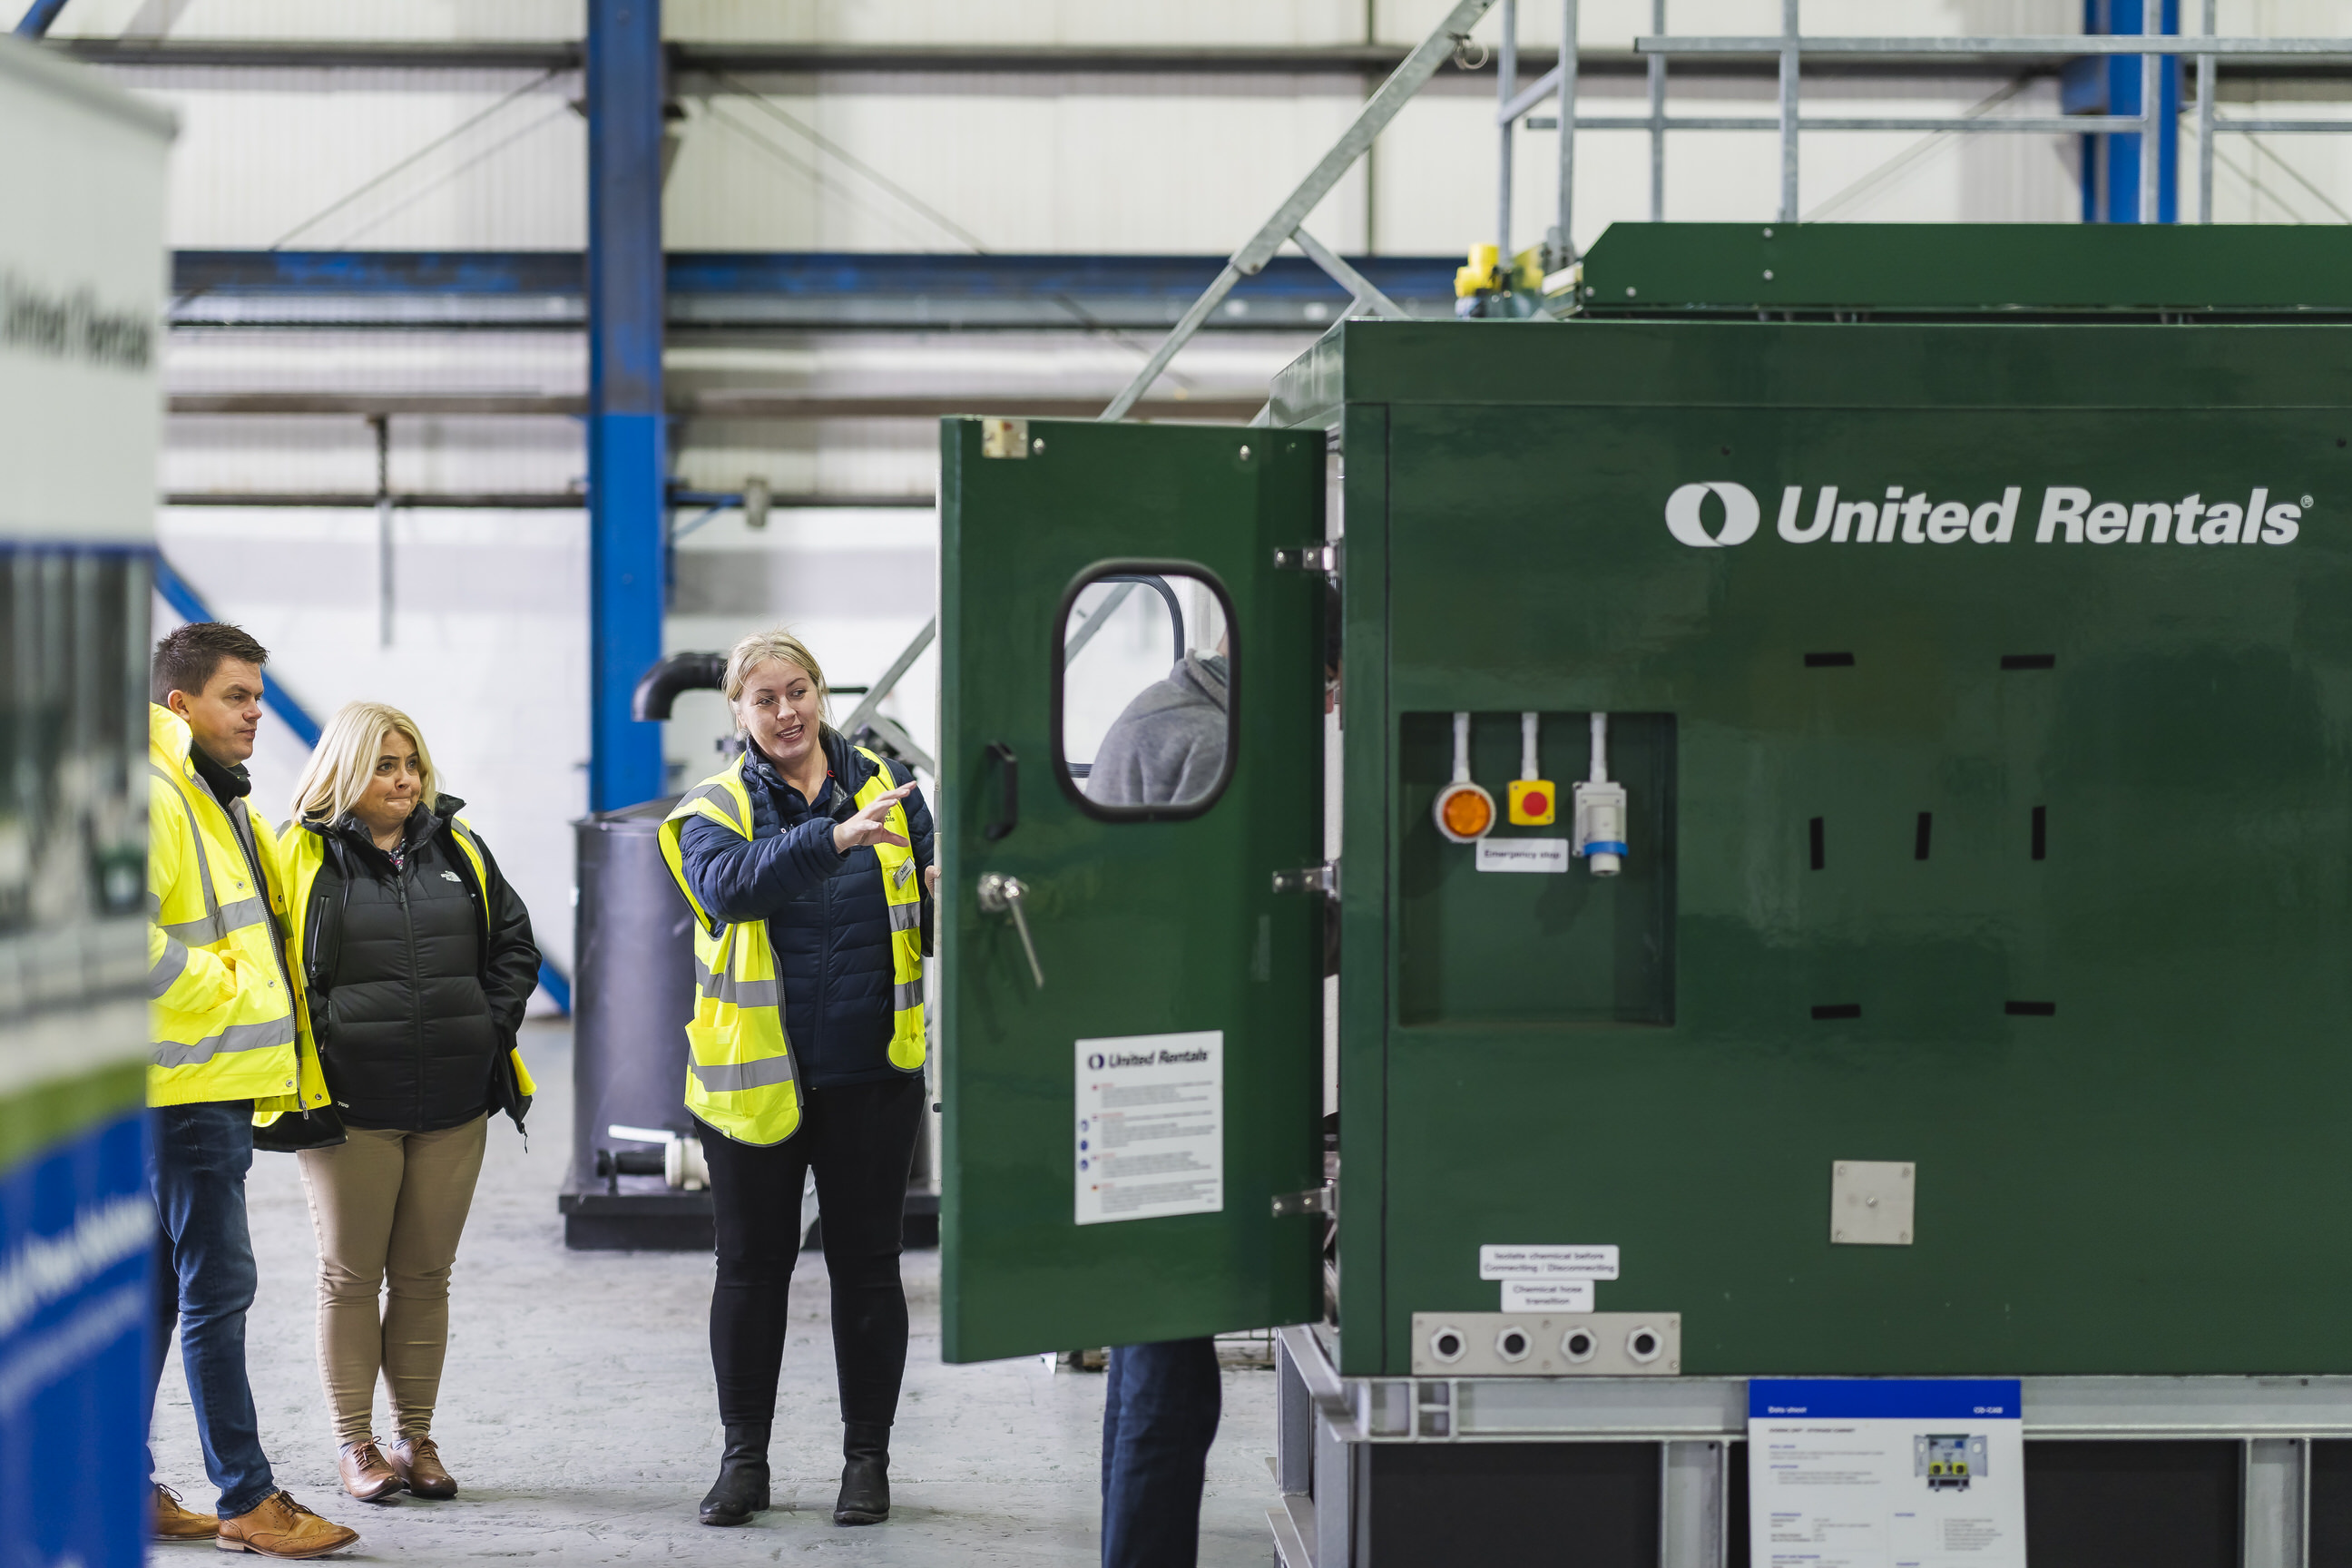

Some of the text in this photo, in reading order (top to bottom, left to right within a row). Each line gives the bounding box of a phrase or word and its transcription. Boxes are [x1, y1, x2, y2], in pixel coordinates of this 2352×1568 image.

[1776, 485, 2022, 544] United
[1485, 849, 1536, 859] Emergency
[1109, 1047, 1207, 1068] United Rentals
[1485, 1263, 1538, 1272] Connecting
[1547, 1263, 1614, 1272] Disconnecting
[1513, 1285, 1583, 1293] Chemical hose
